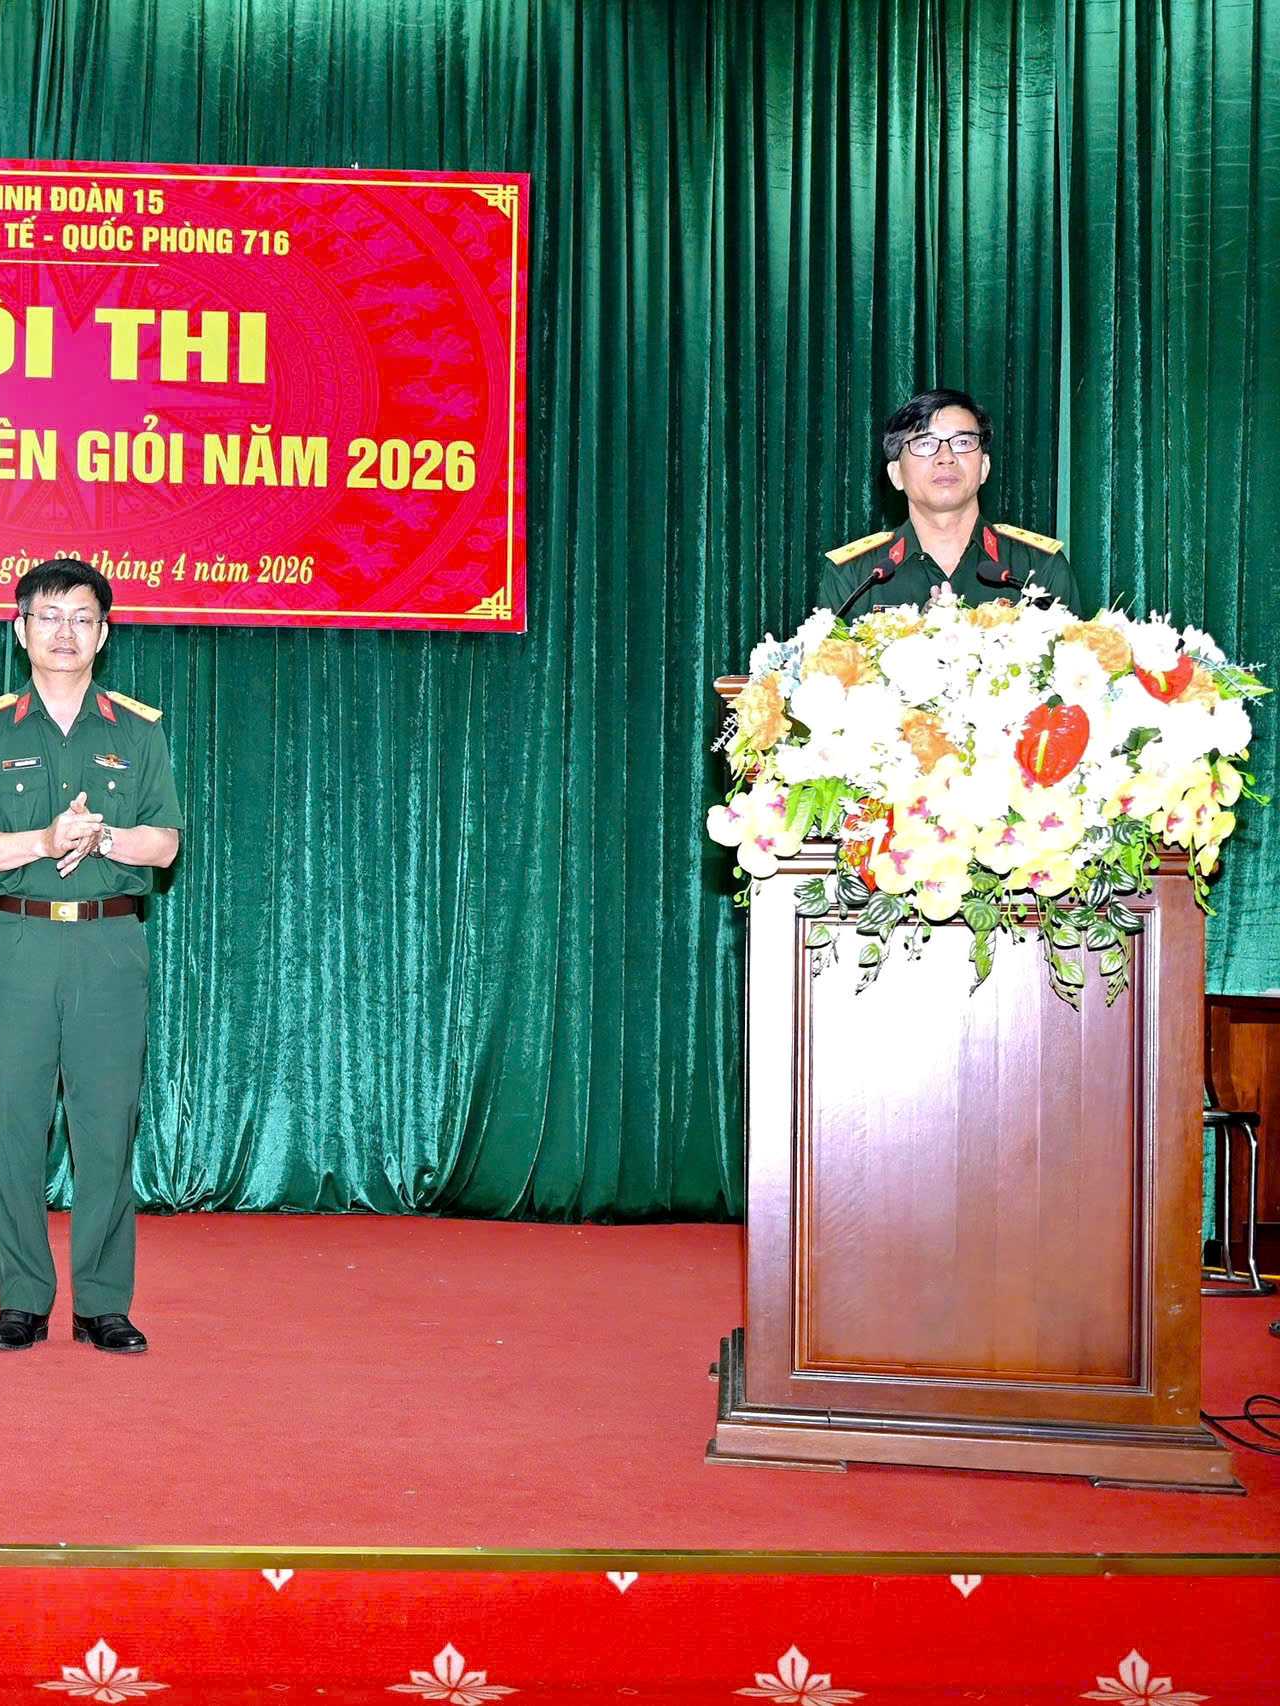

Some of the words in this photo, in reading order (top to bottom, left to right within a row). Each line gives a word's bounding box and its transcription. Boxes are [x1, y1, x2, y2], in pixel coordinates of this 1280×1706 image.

[50, 182, 123, 214] ĐOÀN
[133, 189, 164, 215] 15
[5, 215, 37, 249] TẾ
[62, 216, 133, 252] QUỐC
[142, 222, 233, 254] PHÒNG
[241, 229, 290, 256] 716
[94, 307, 267, 384] THI
[77, 414, 184, 484] GIỎI
[204, 420, 328, 488] NĂM
[346, 438, 477, 492] 2026
[171, 553, 186, 581] 4
[194, 554, 250, 583] năm
[257, 555, 314, 585] 2026
